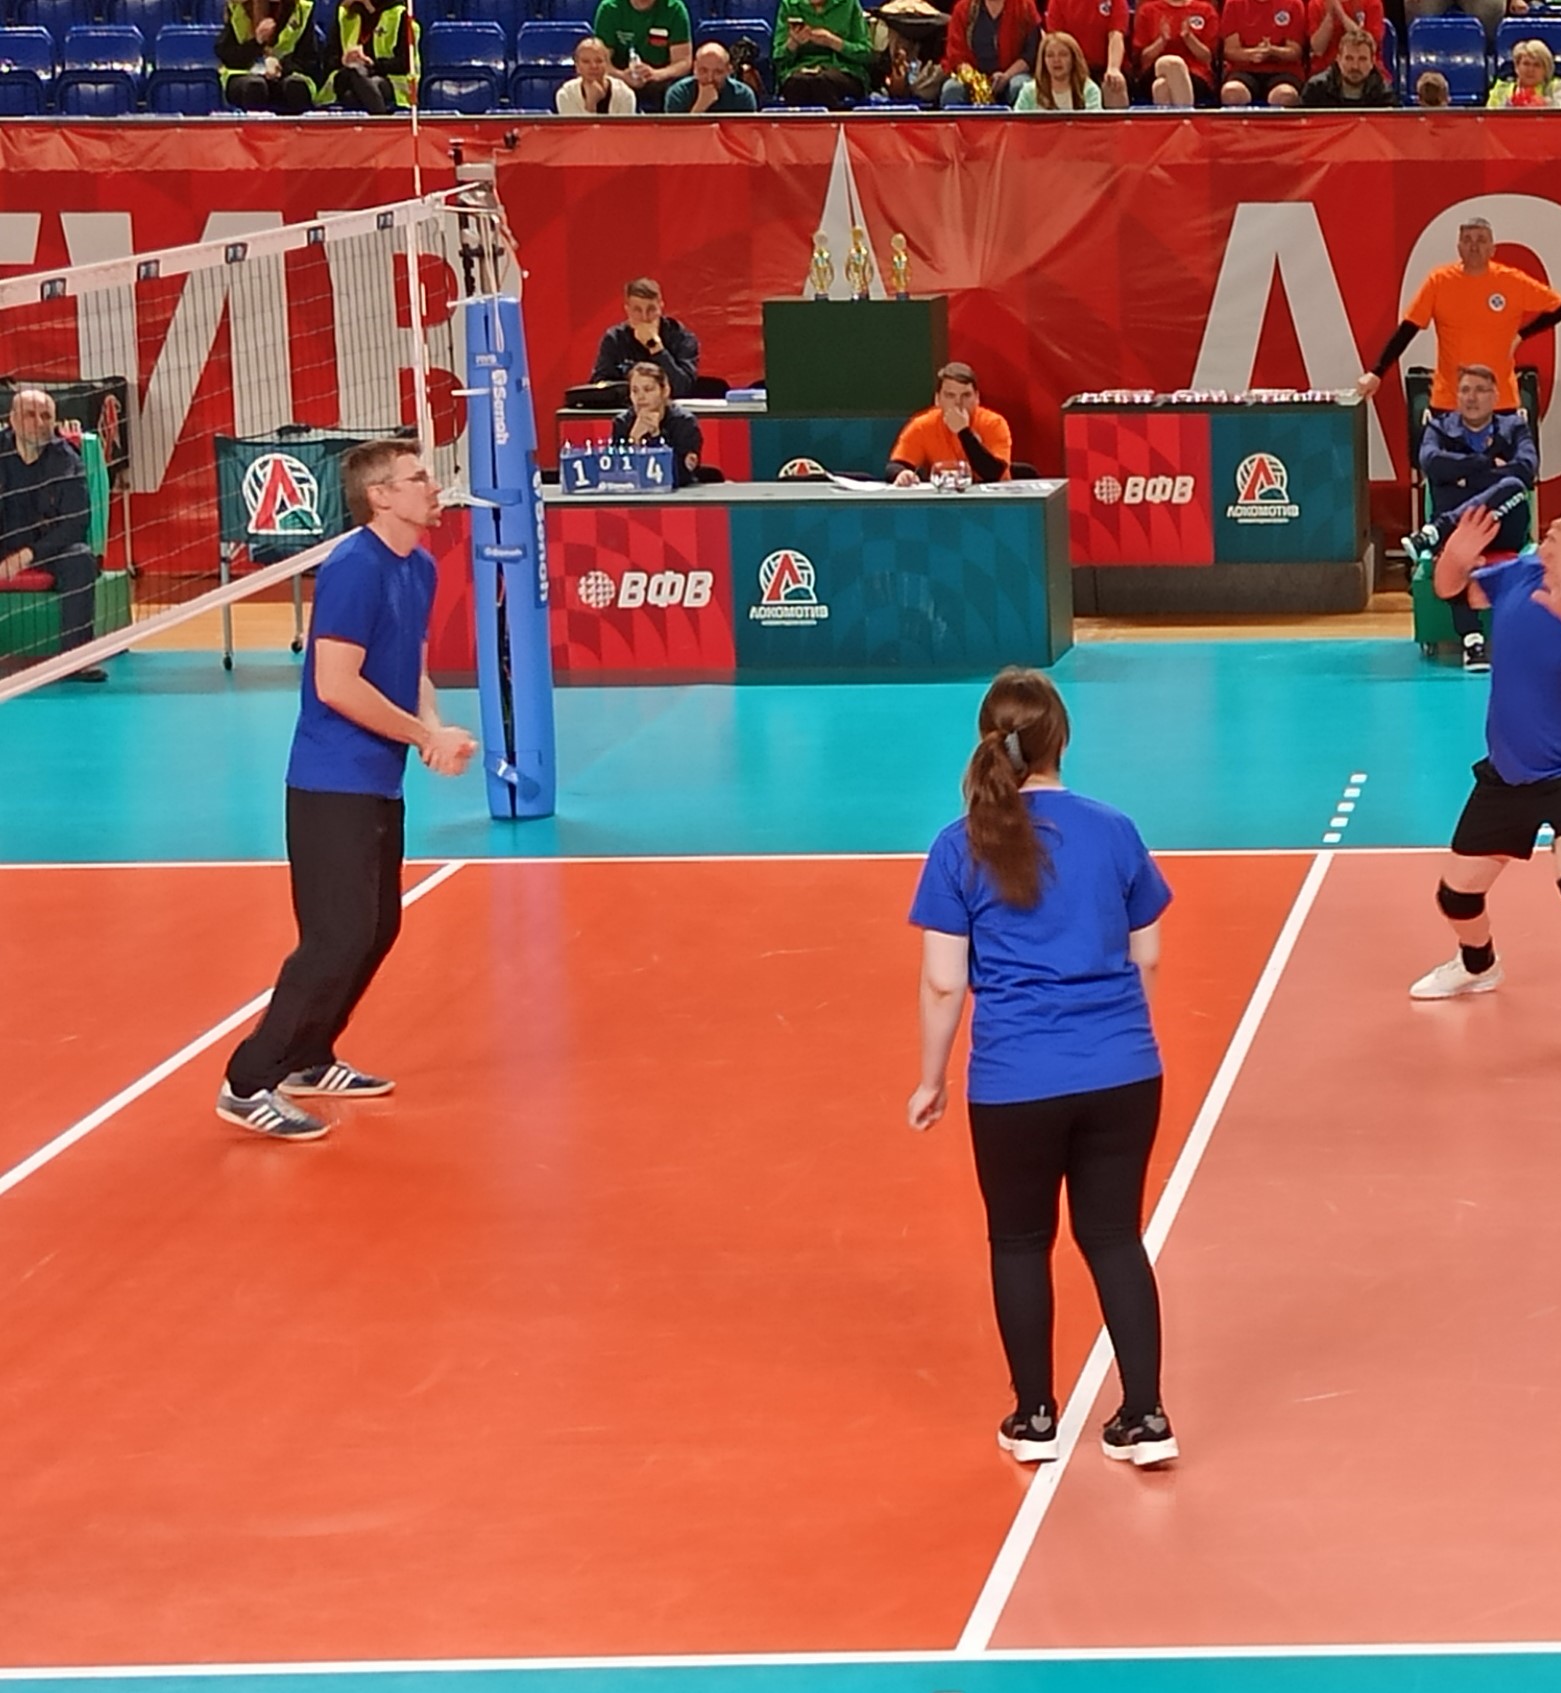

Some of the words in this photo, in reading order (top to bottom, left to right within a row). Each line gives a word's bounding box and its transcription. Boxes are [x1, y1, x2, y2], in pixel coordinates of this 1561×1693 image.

[572, 459, 591, 487] 1
[599, 455, 612, 471] 0
[622, 455, 633, 471] 1
[646, 456, 664, 484] 4
[1123, 475, 1195, 505] ВФВ
[617, 570, 714, 609] ВФВ
[748, 604, 829, 620] ЛОКОМОТИВ
